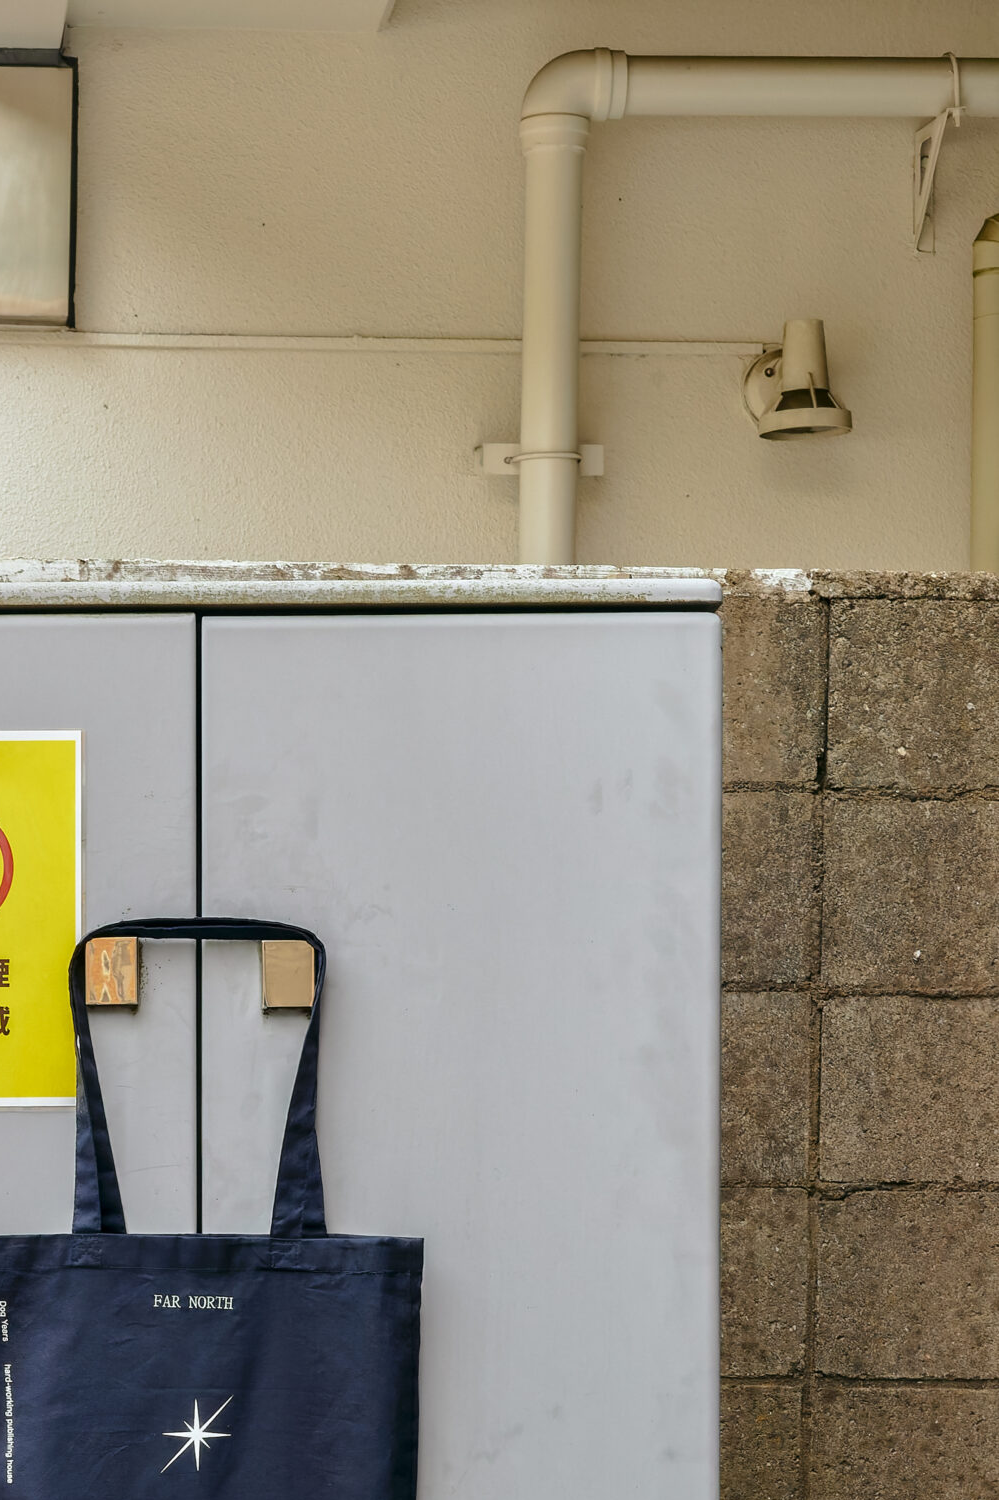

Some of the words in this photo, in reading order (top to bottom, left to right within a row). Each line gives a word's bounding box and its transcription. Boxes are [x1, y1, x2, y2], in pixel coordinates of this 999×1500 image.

[153, 1294, 182, 1309] FAR
[188, 1295, 234, 1310] NORTH
[1, 1319, 9, 1342] Years
[4, 1364, 14, 1417] hard-working
[5, 1419, 15, 1458] publishing
[6, 1460, 14, 1484] house
